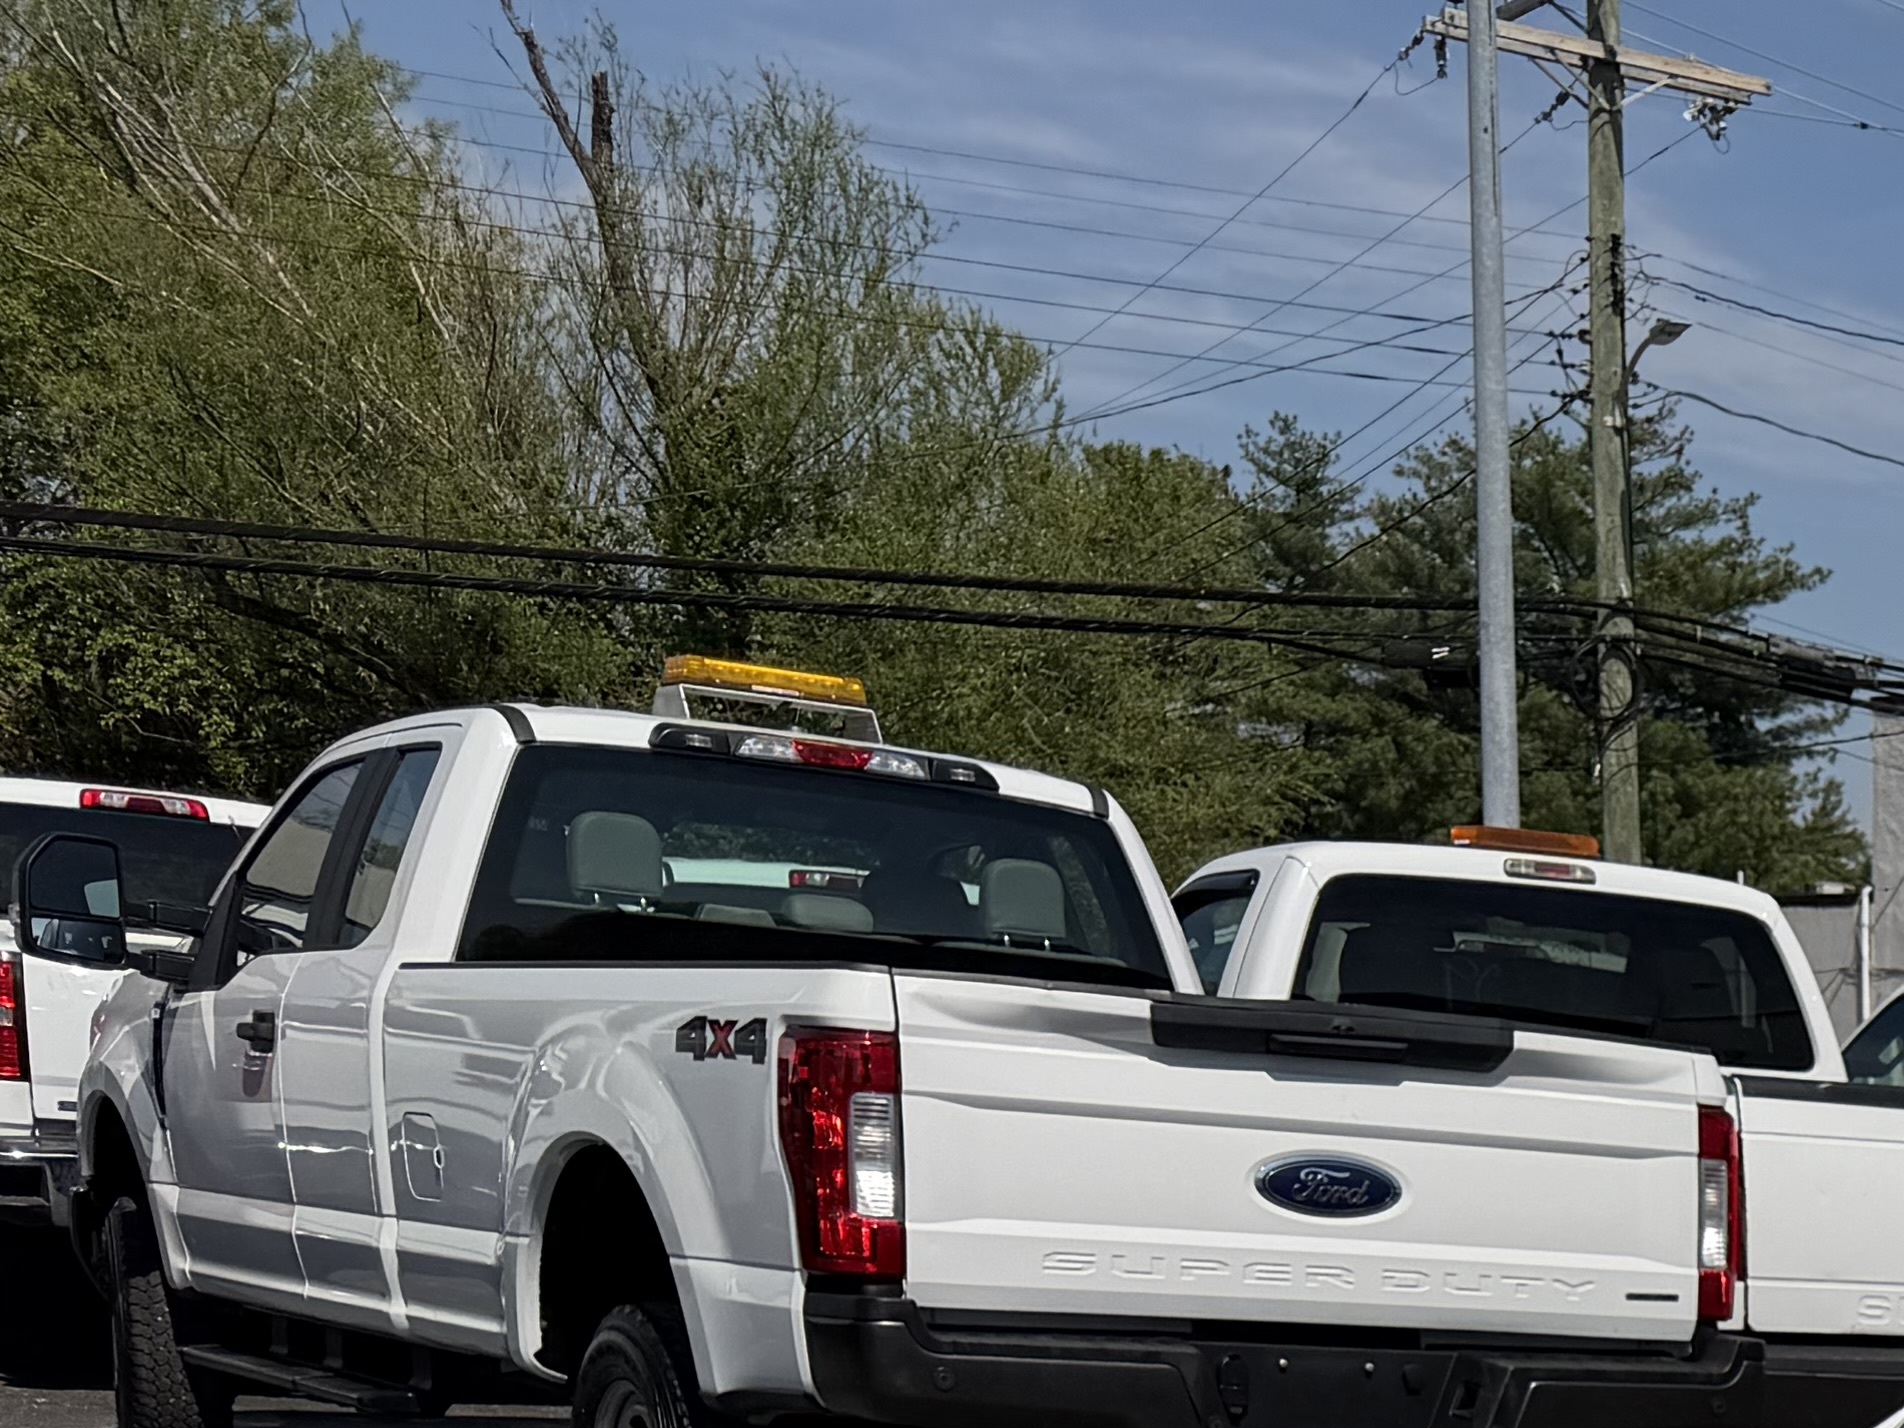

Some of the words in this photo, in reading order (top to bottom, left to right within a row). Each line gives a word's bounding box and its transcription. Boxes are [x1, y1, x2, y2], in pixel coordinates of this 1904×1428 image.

[1292, 1167, 1372, 1204] Ford
[1042, 1250, 1356, 1290] SUPER
[1380, 1267, 1597, 1301] DUTY
